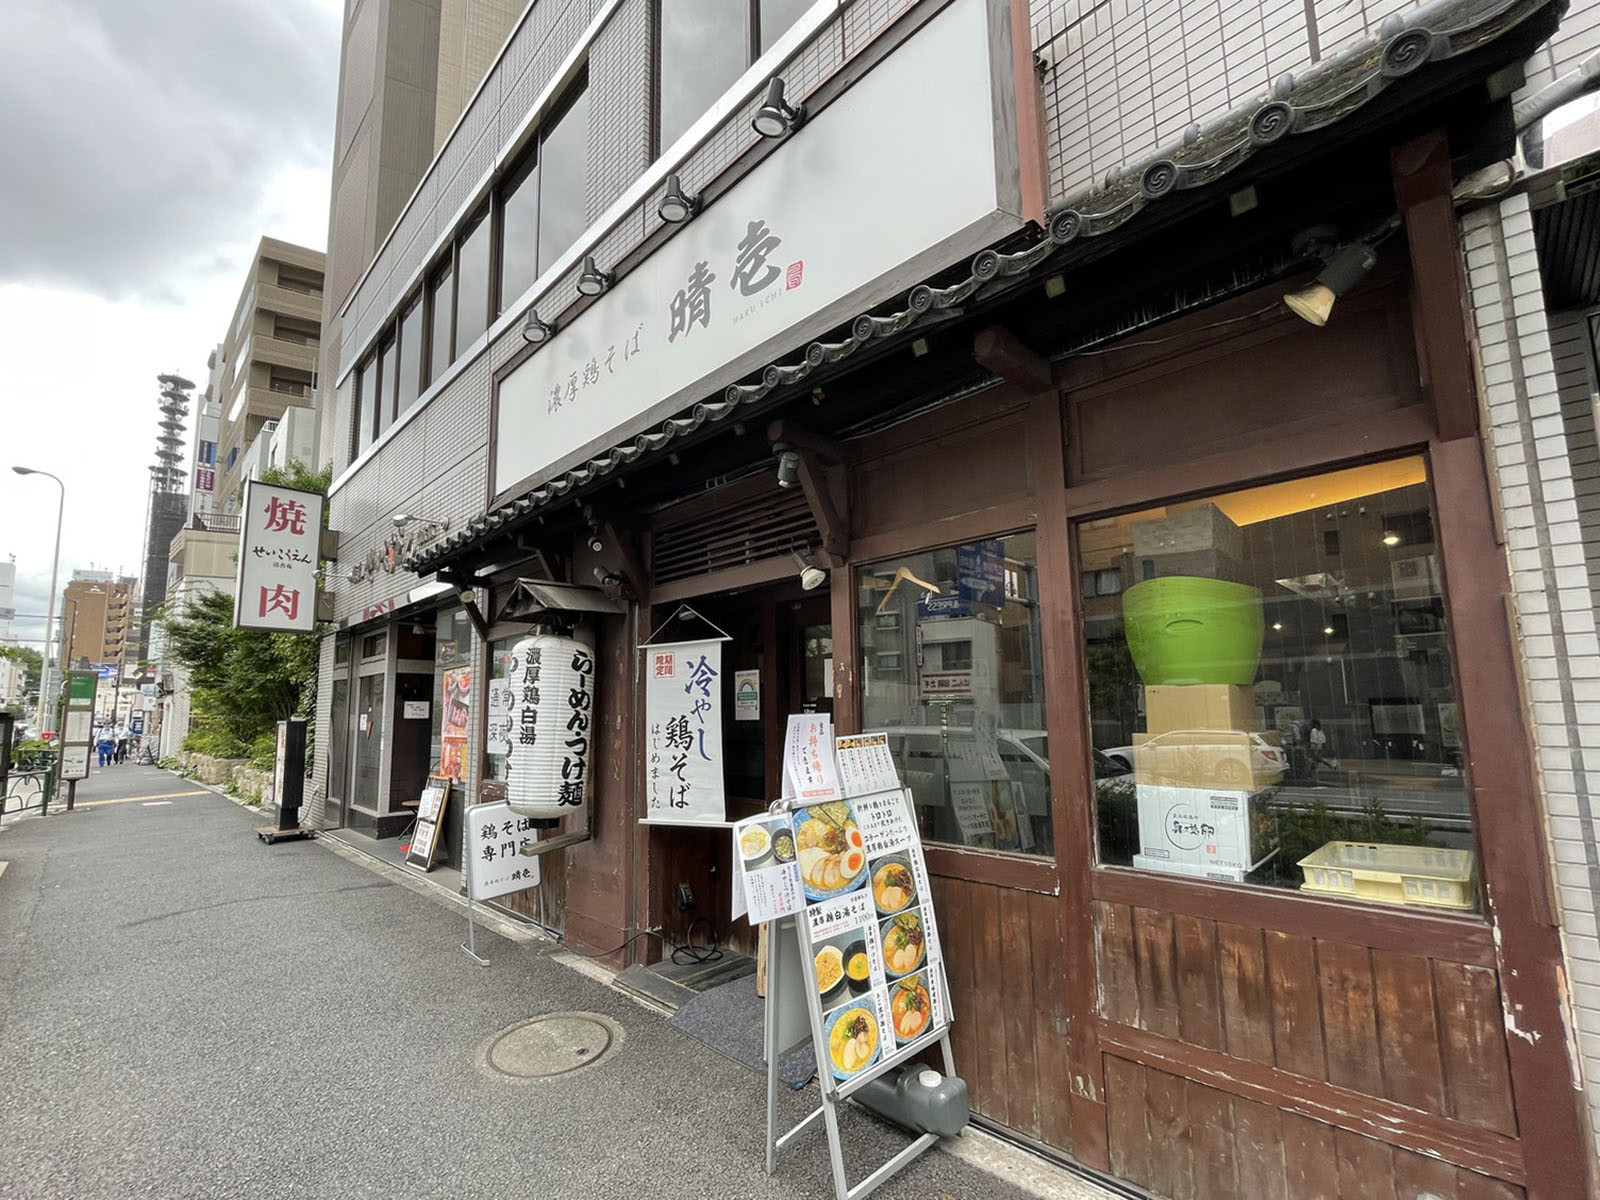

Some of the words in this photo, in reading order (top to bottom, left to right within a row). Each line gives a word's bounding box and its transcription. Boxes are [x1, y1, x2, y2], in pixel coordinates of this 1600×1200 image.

[548, 322, 644, 415] 濃厚鶏そば
[253, 546, 312, 564] せいこうえん
[263, 496, 307, 536] 焼
[258, 584, 300, 620] 肉
[519, 647, 542, 745] 濃厚鶏白湯
[684, 655, 718, 761] 冷やし
[650, 723, 661, 809] はじめました
[665, 715, 694, 809] 鶏そば
